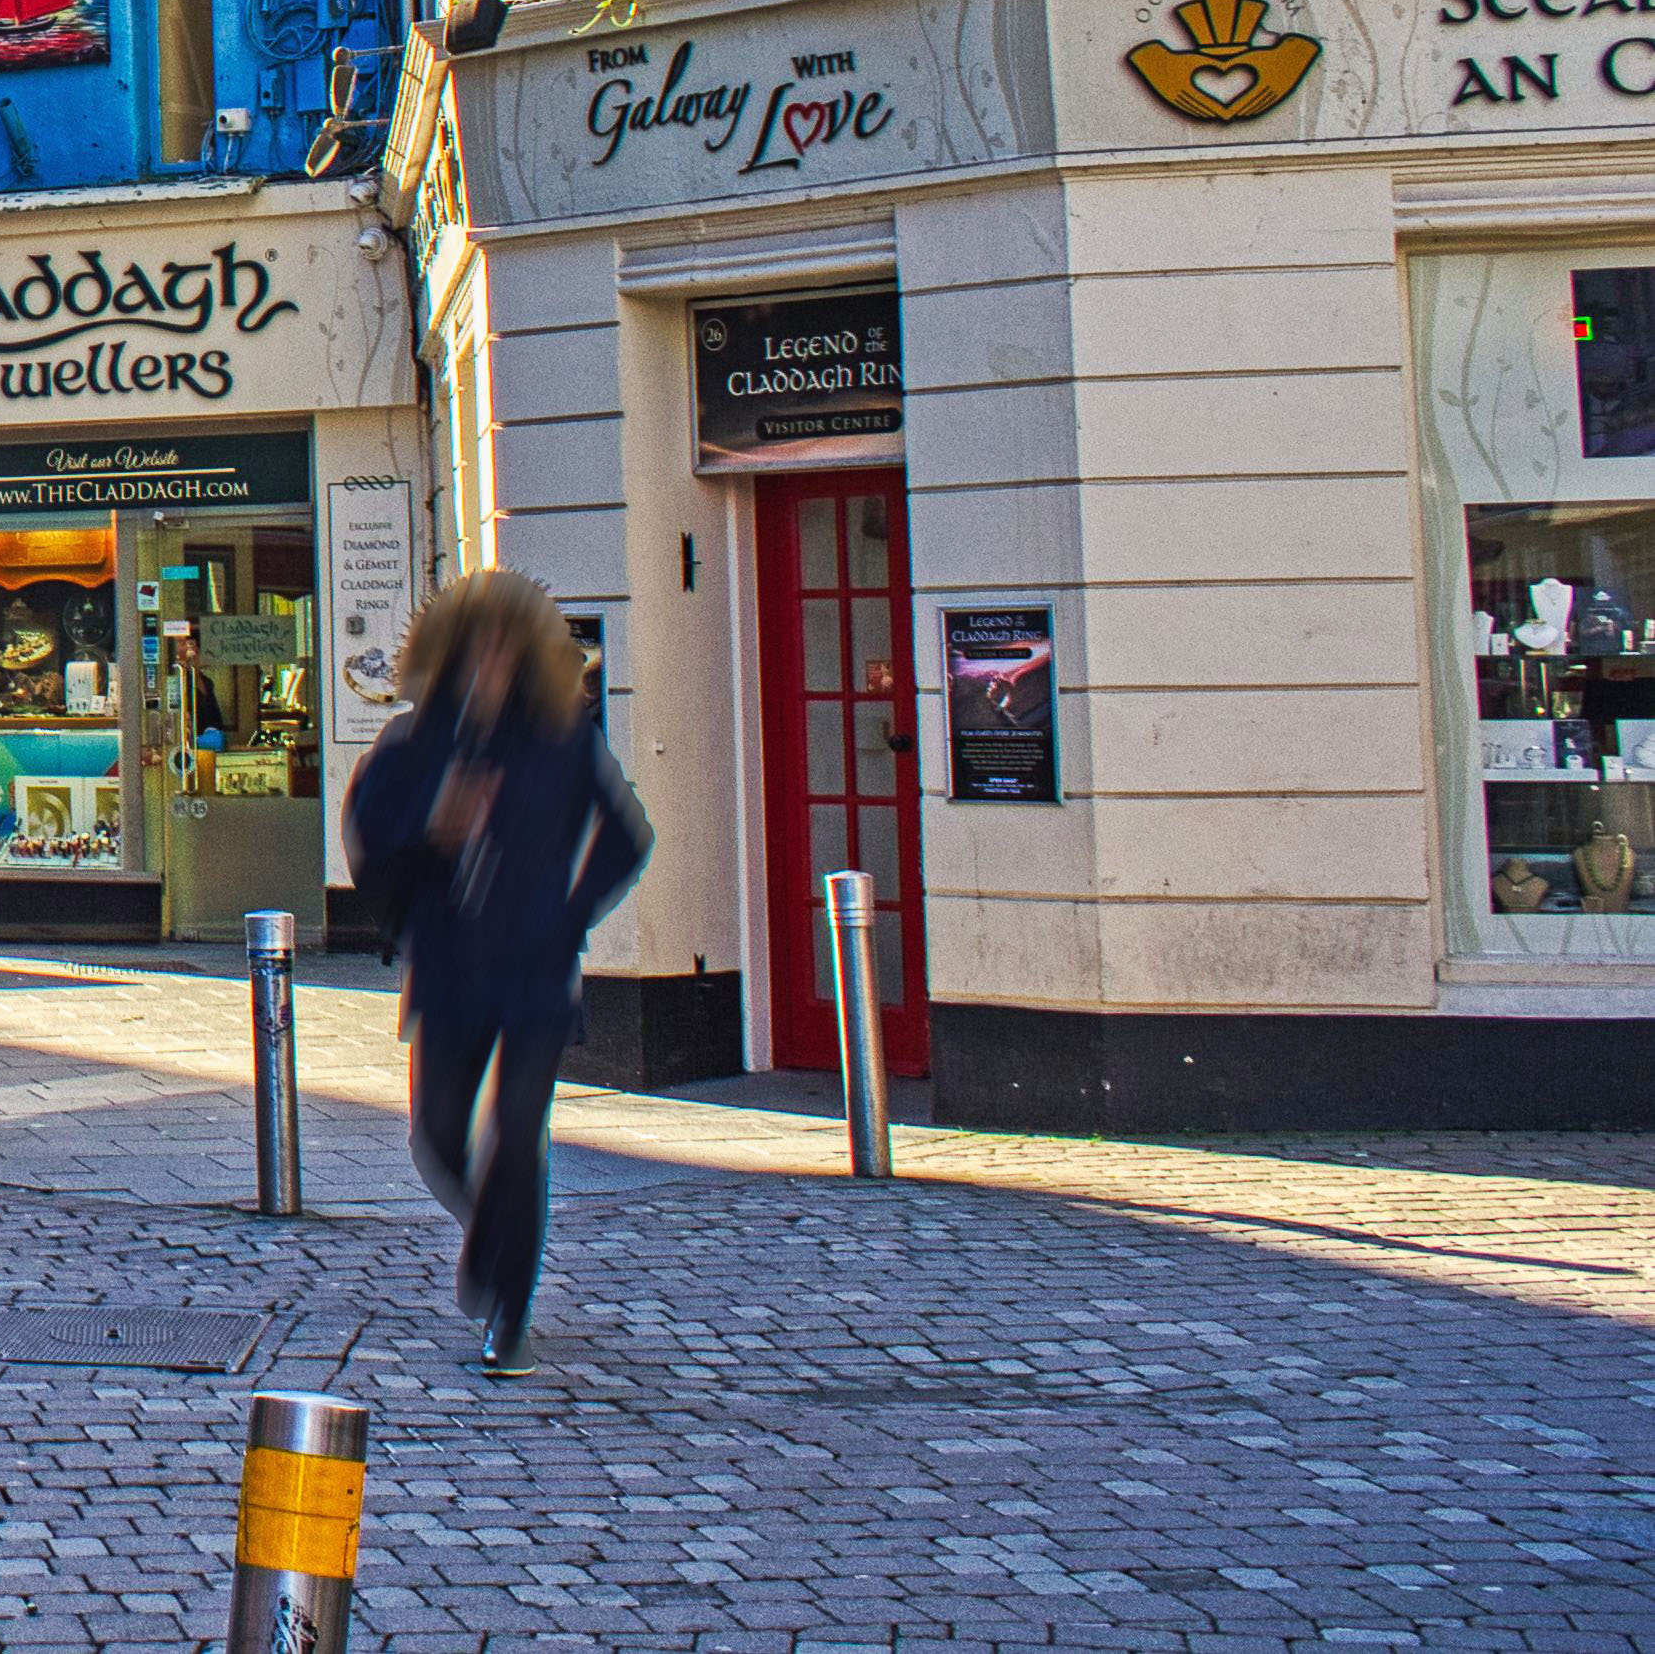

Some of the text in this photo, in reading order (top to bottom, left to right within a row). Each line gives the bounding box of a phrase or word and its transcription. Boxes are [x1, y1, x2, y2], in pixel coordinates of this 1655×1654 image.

[587, 44, 855, 80] FROM WITH
[1451, 53, 1559, 107] AN
[587, 41, 752, 166] Galway
[706, 328, 722, 343] 26
[764, 330, 858, 361] LEGEND
[726, 364, 853, 396] CLADDAGH
[764, 414, 891, 436] VISITOR CENTRE
[46, 446, 179, 472] Visit our Website
[349, 522, 392, 531] EXCLUSIVE
[343, 540, 399, 551] DIAMOND
[341, 579, 402, 591] CLADDAGH
[355, 599, 390, 610] RINGS
[969, 615, 1013, 628] LEGEND
[1012, 629, 1043, 642] RING
